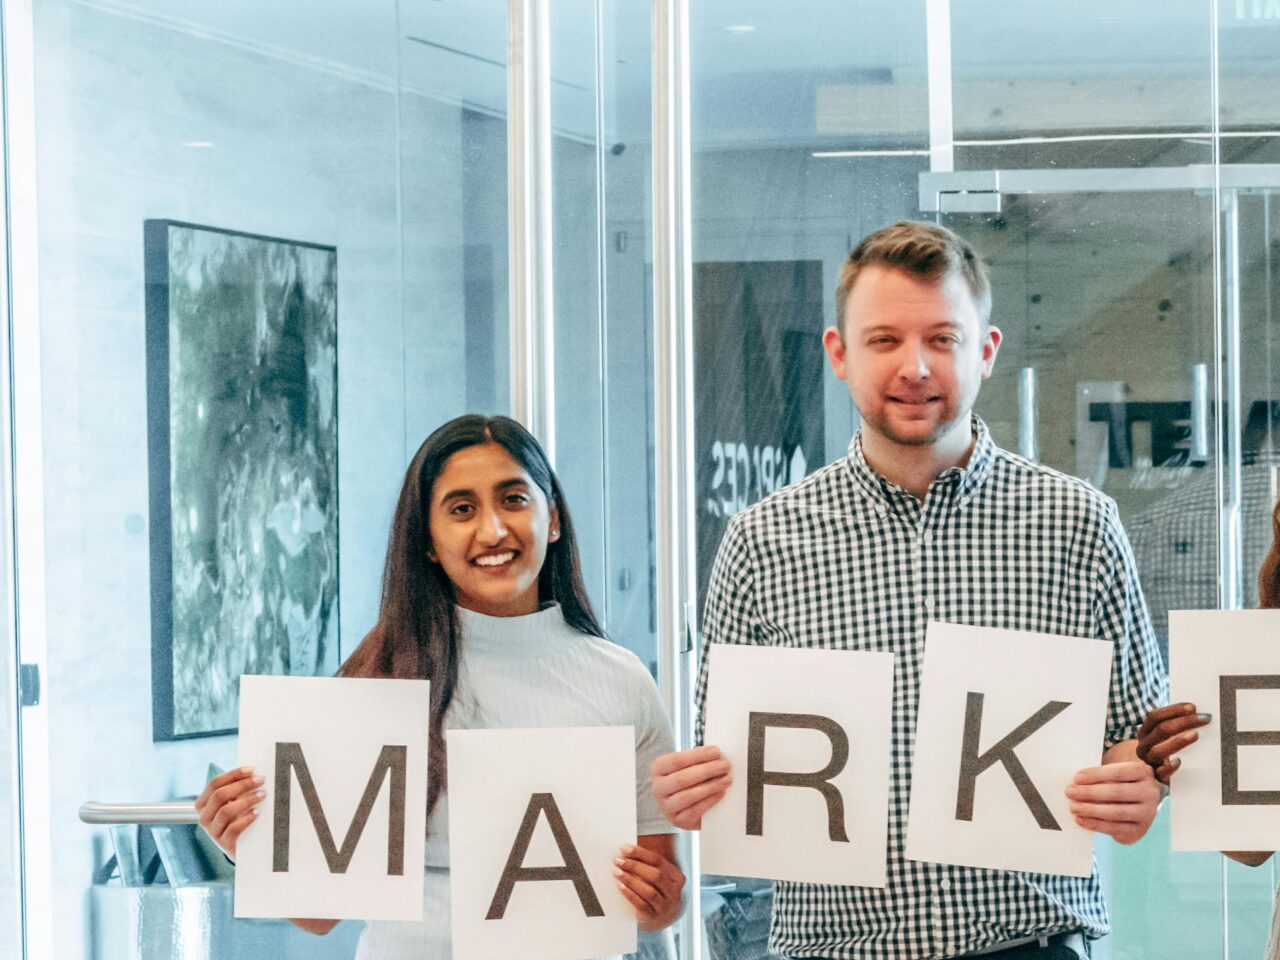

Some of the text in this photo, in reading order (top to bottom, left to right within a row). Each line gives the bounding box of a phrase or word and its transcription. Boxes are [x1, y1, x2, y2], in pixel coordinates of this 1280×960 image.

[273, 743, 407, 875] M
[746, 712, 850, 842] R
[956, 692, 1072, 831] K
[485, 793, 605, 920] A
